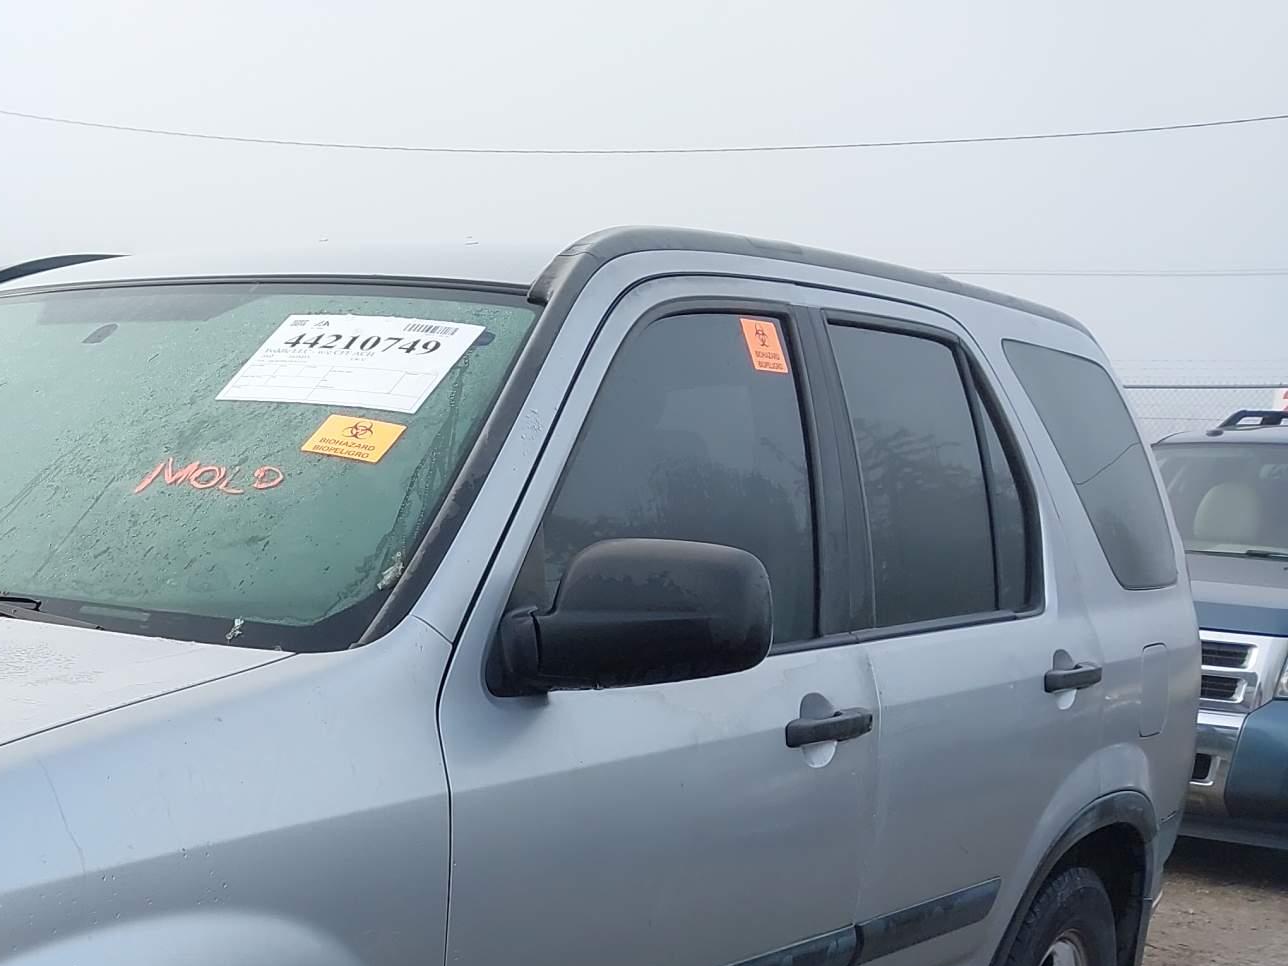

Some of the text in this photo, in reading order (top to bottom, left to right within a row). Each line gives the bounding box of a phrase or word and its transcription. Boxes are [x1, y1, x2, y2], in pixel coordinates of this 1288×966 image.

[284, 333, 440, 355] 44210749
[312, 444, 370, 458] BIOPELIGRO
[318, 437, 376, 451] BIOHAZARD
[134, 457, 284, 494] MOLD
